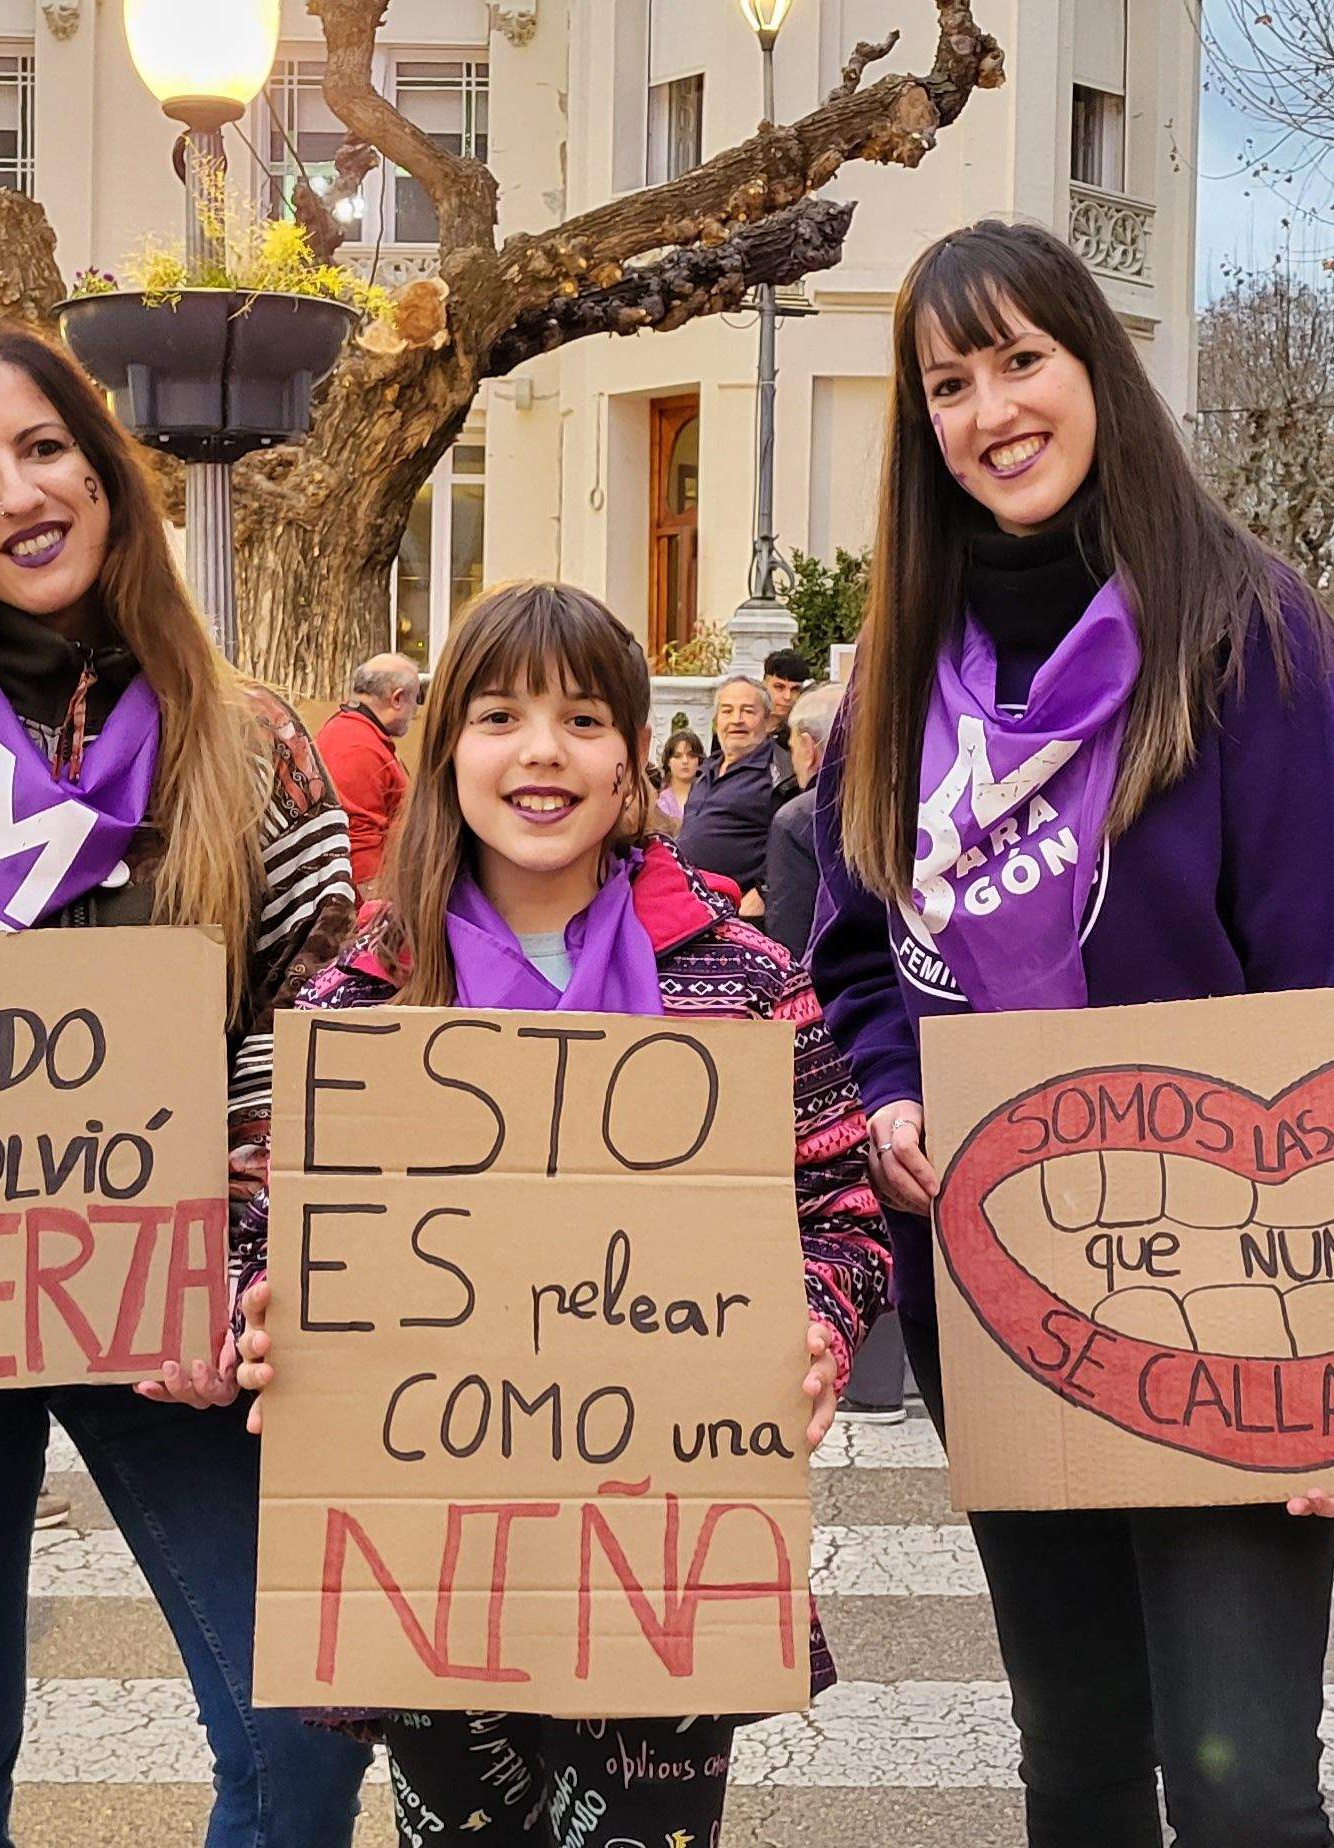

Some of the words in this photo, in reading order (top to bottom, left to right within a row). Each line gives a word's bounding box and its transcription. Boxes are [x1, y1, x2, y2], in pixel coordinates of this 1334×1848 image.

[956, 794, 1058, 879] ARA
[964, 826, 1078, 917] GÓN
[304, 1019, 720, 1176] ESTO
[1009, 1082, 1234, 1156] SOMOS
[1253, 1108, 1334, 1173] LAS
[300, 1204, 476, 1332] ES
[530, 1230, 751, 1354] pelear
[1085, 1231, 1180, 1292] que
[1027, 1310, 1117, 1399] SE
[383, 1372, 636, 1464] COMO
[672, 1418, 795, 1461] una
[315, 1475, 796, 1685] NIÑA
[606, 1731, 696, 1789] obvious
